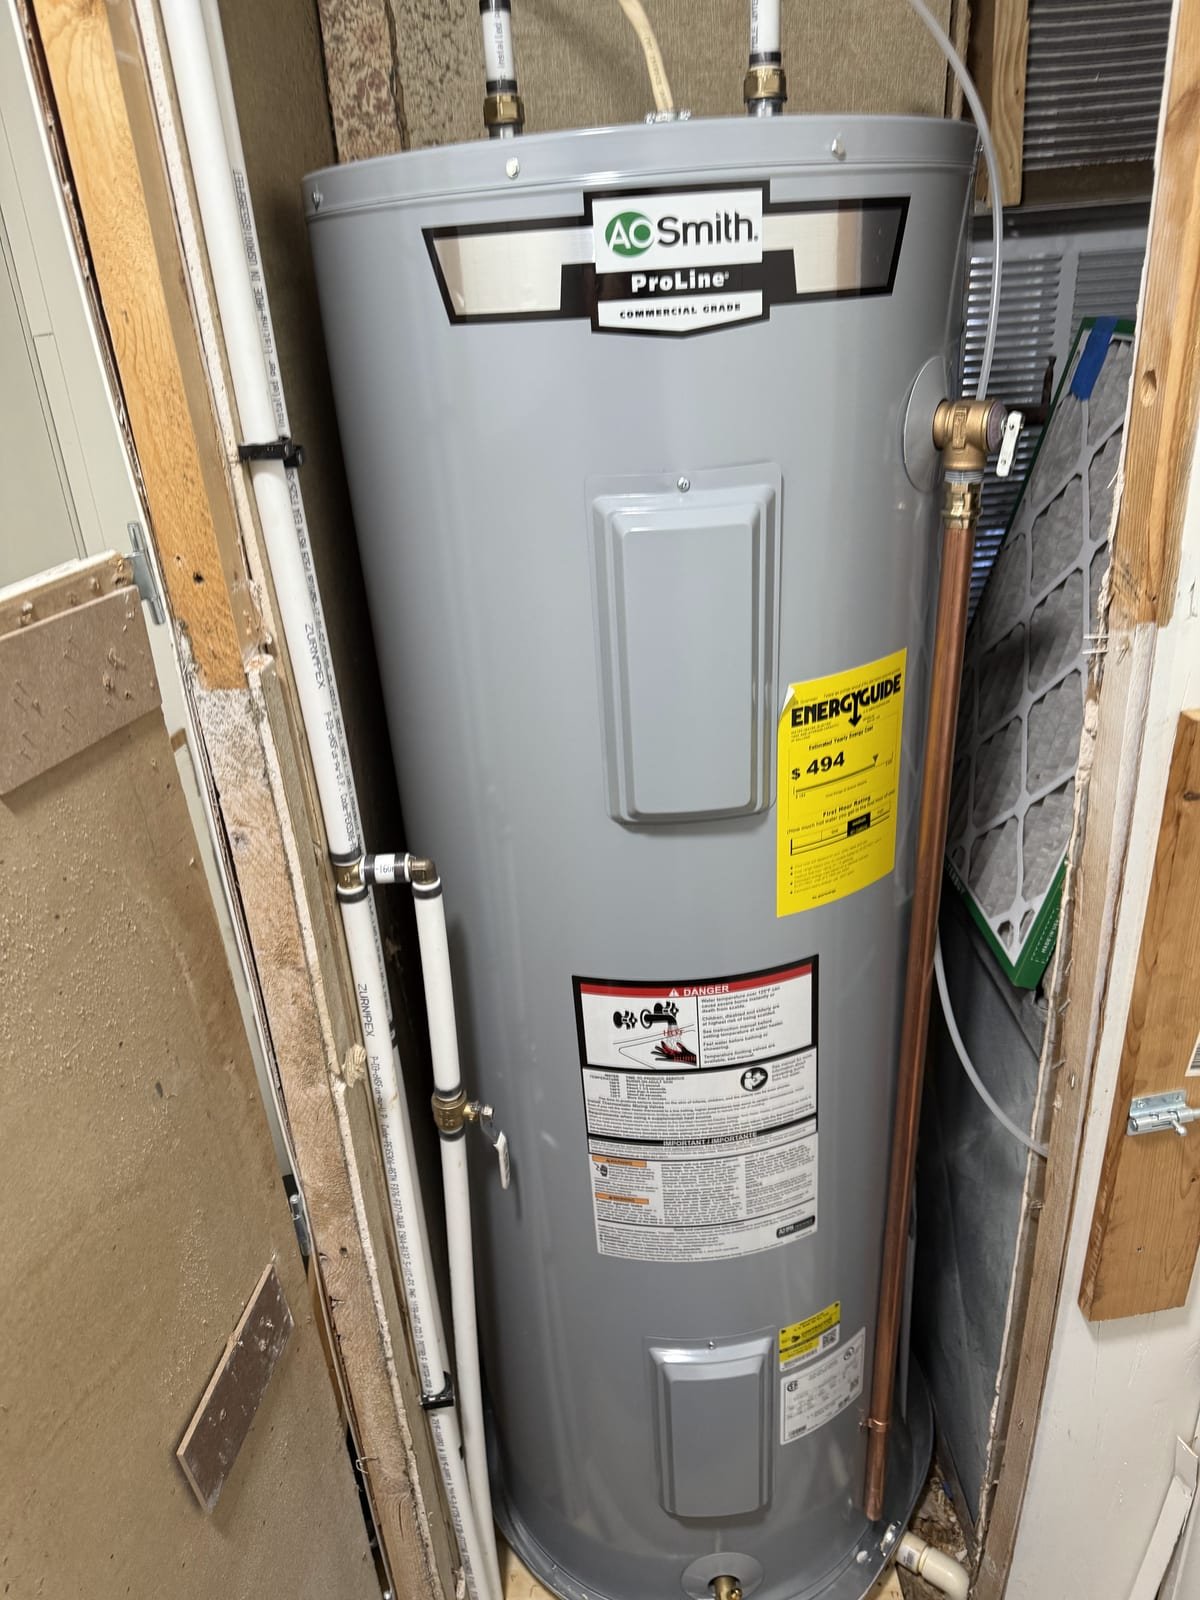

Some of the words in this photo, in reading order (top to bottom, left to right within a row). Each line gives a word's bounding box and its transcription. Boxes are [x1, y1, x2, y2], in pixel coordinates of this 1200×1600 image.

[657, 208, 754, 247] Smith
[631, 268, 724, 293] ProLine
[620, 306, 698, 319] COMMERCIAL
[703, 303, 741, 314] GRADE
[791, 673, 902, 728] ENERGYGUIDE
[792, 768, 801, 780] $
[806, 751, 846, 776] 494
[823, 809, 837, 818] First
[839, 804, 853, 812] Hour
[854, 795, 871, 806] Rating
[683, 984, 729, 997] DANGER
[663, 1138, 705, 1147] IMPORTANT
